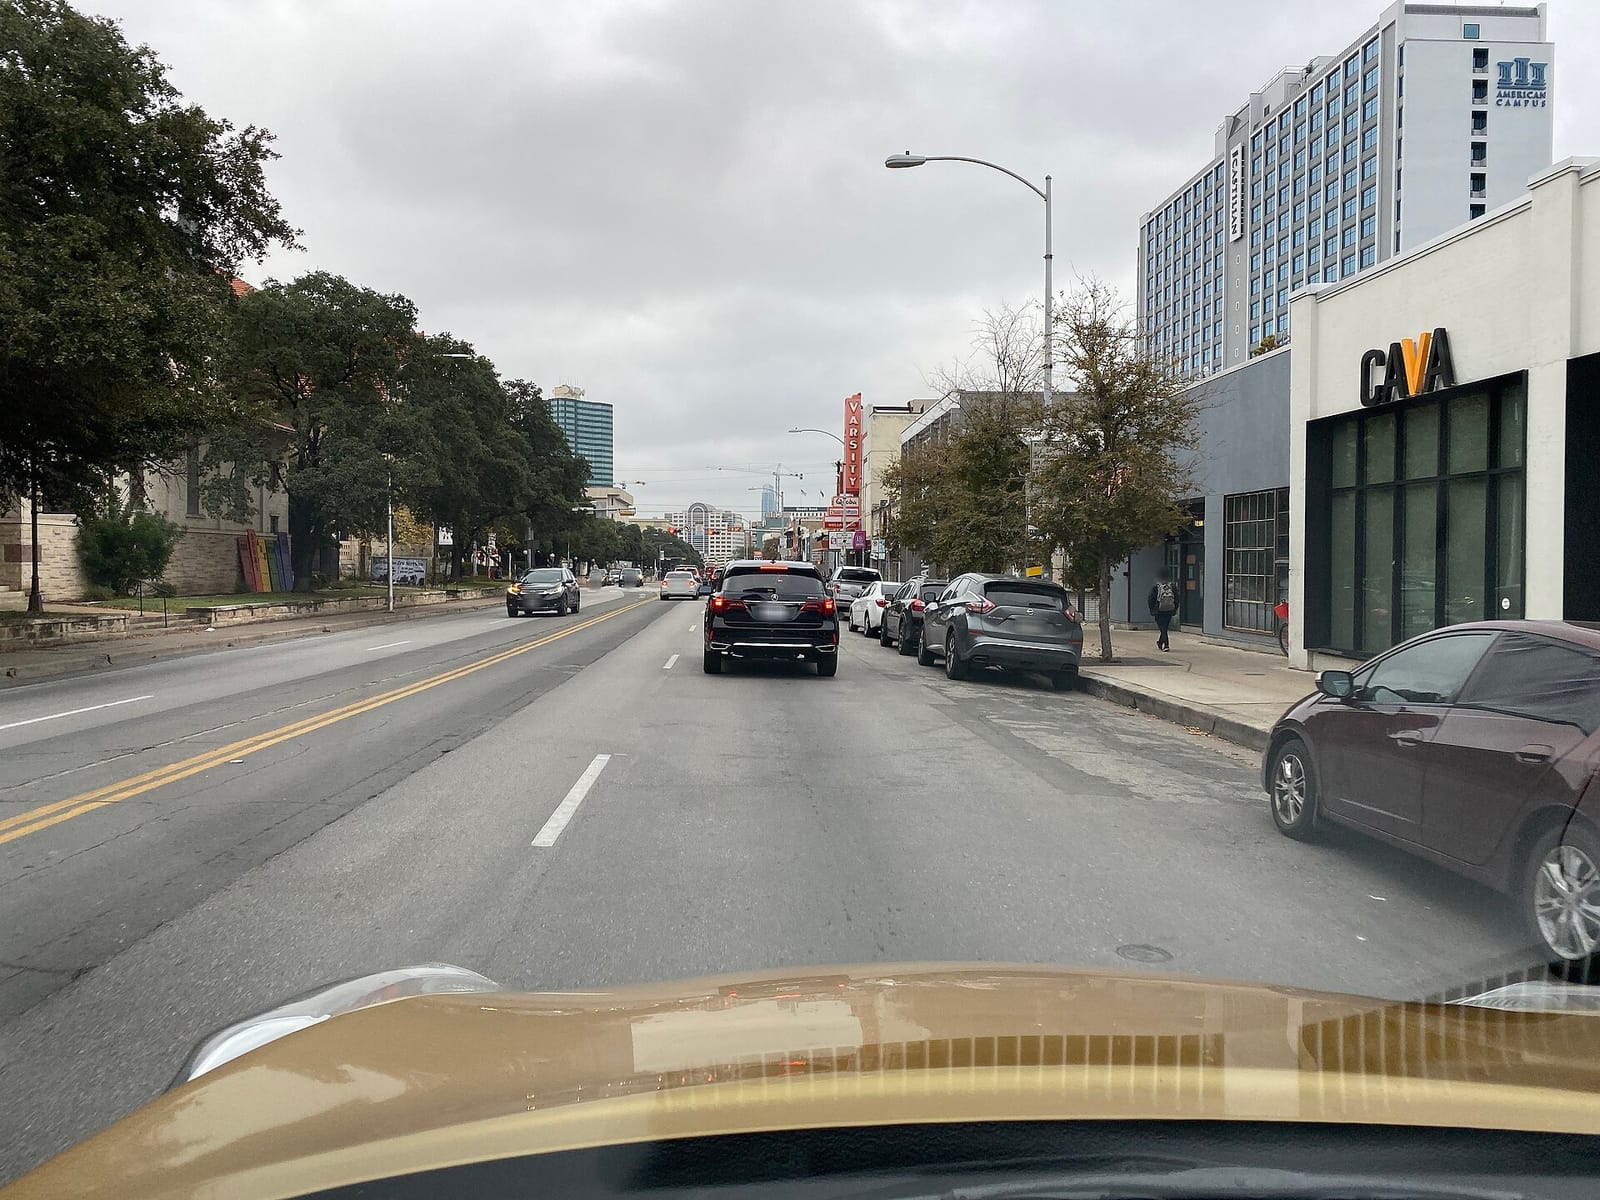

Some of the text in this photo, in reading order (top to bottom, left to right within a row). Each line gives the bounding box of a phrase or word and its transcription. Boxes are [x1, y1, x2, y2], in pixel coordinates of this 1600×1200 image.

[1496, 91, 1546, 99] AMERICAN
[1496, 99, 1546, 107] CAMPUS
[1360, 327, 1455, 407] CAVA
[848, 402, 858, 486] VARSITY
